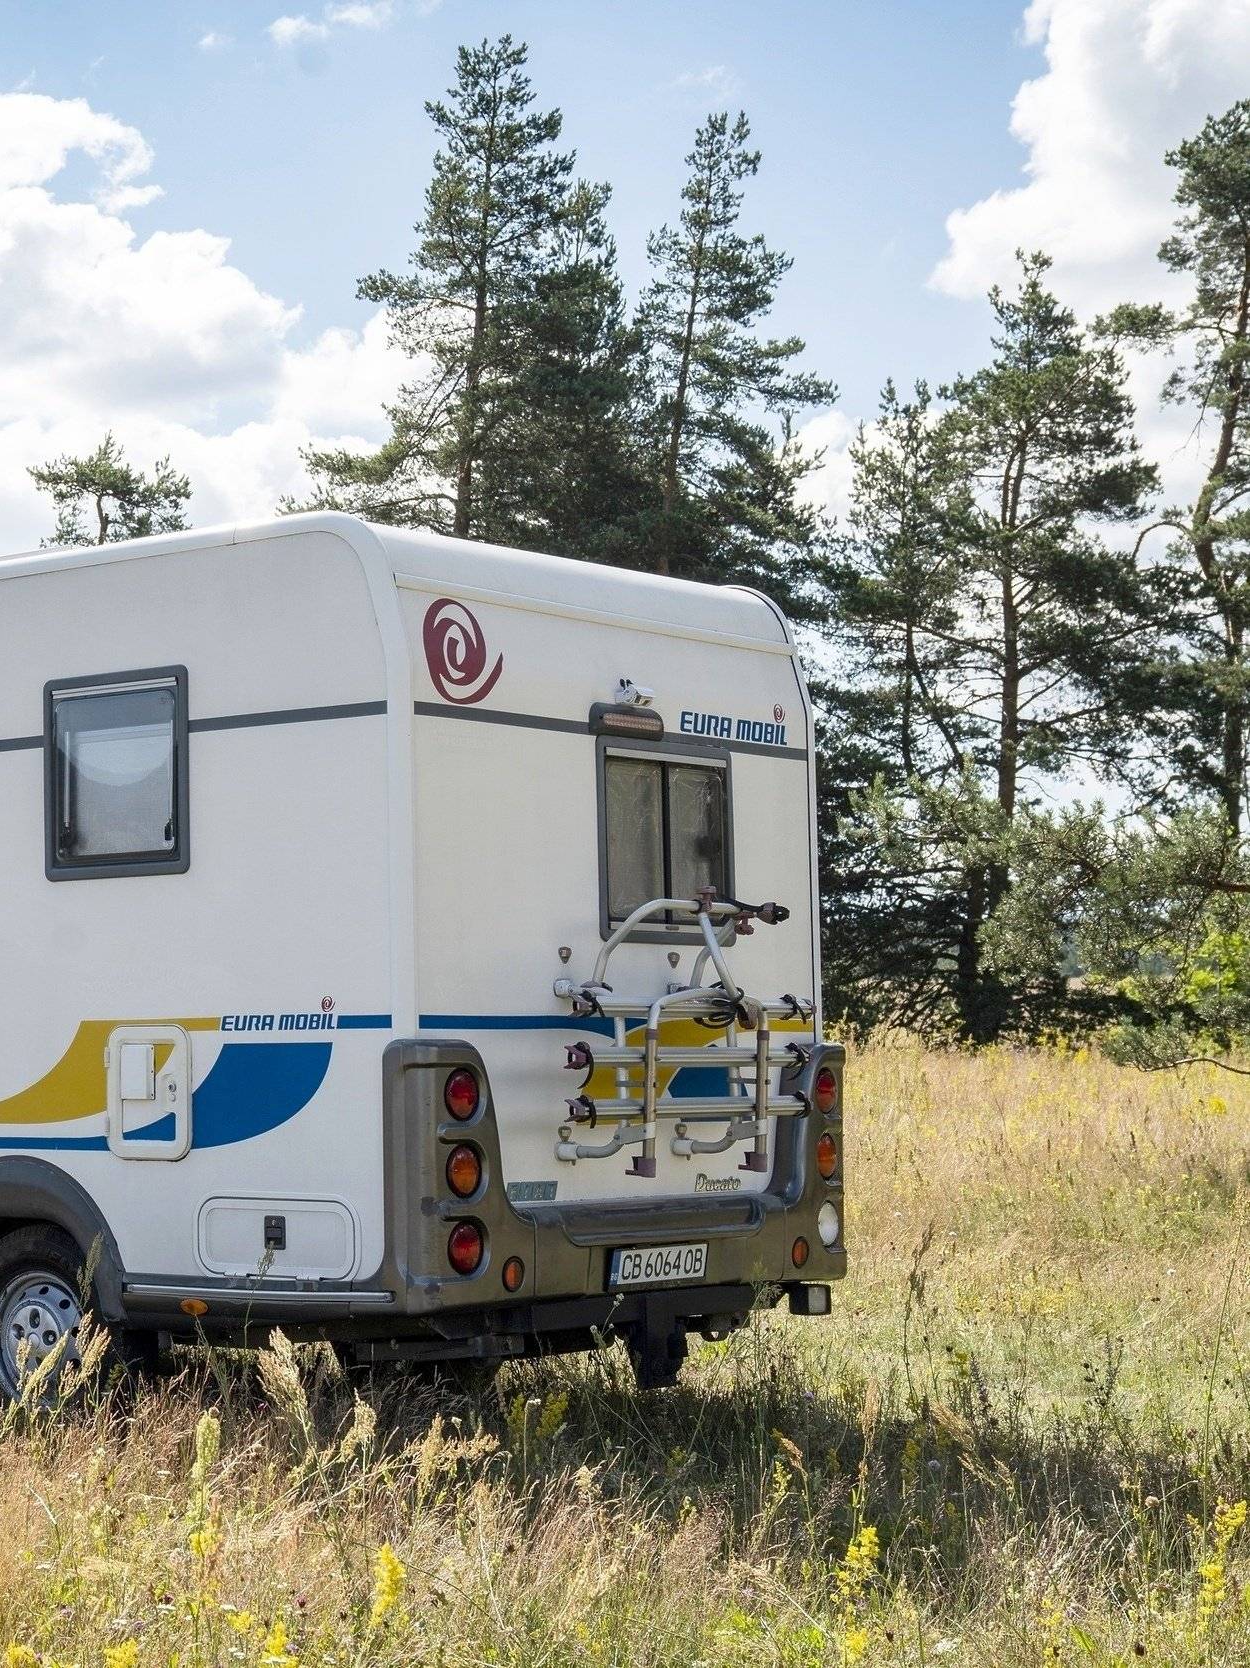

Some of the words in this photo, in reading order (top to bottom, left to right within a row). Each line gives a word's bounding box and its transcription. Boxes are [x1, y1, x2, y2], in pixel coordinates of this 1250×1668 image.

[680, 710, 733, 739] EURA
[735, 718, 788, 747] MOBIL
[220, 1014, 275, 1032] EURA
[277, 1013, 337, 1031] MOBIL
[694, 1172, 742, 1192] Ducato
